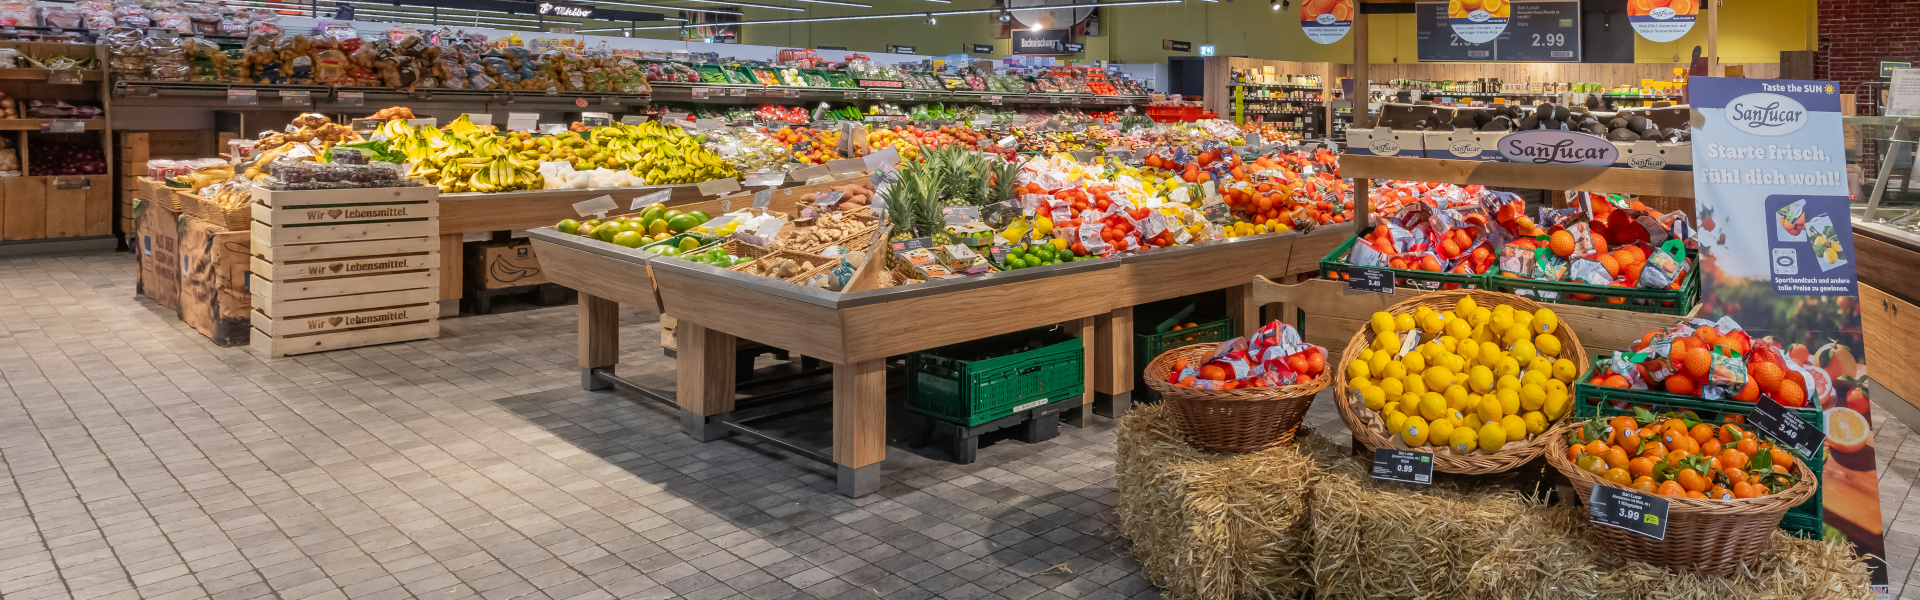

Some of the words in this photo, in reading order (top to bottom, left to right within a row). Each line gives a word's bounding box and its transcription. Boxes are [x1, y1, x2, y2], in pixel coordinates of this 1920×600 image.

[555, 6, 592, 17] Tchibo
[1532, 33, 1565, 47] 2.99
[1762, 83, 1785, 92] Taste
[1788, 84, 1802, 92] the
[1804, 84, 1822, 93] SUN
[1732, 102, 1802, 128] SanLucar
[1371, 143, 1398, 153] SanLucar
[1452, 143, 1480, 154] SanLucar
[1509, 139, 1609, 164] SanLucar
[1708, 142, 1766, 160] Starte
[1768, 144, 1830, 163] frisch,
[1631, 157, 1663, 168] SanLucar
[1701, 168, 1740, 184] fühl
[1745, 168, 1785, 185] dich
[1789, 170, 1841, 186] wohl!
[307, 211, 324, 220] Wir
[345, 207, 408, 218] Lebensmittel.
[308, 265, 326, 274] Wir
[346, 259, 409, 272] Lebensmittel.
[308, 320, 325, 329] Wir
[345, 311, 408, 325] Lebensmittel.
[1779, 424, 1797, 439] 3.49
[1619, 508, 1640, 520] 3.99
